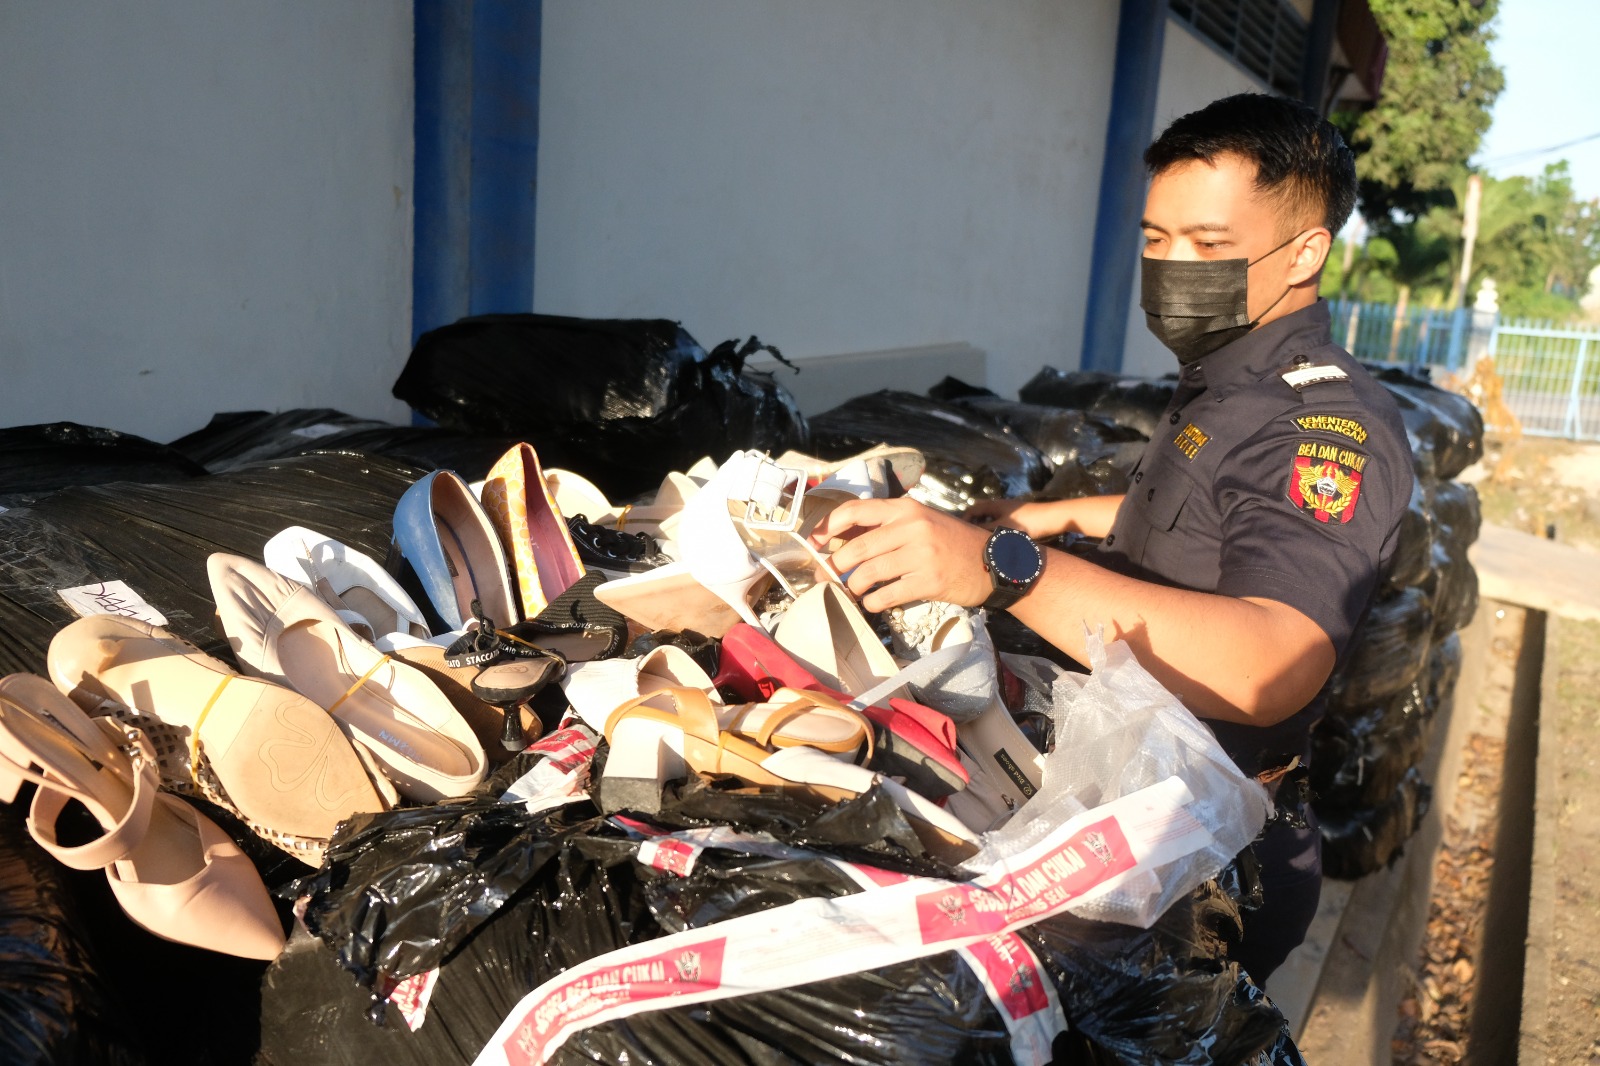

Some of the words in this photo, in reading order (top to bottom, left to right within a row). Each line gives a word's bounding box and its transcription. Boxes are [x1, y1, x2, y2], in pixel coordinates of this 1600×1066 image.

[1297, 415, 1367, 441] KEMENTERIAN
[1303, 422, 1363, 444] KEUANGAN
[1297, 443, 1317, 457] BEA
[1318, 445, 1338, 461] DAN
[1339, 450, 1365, 472] CUKAI
[465, 649, 500, 665] STACCATO
[1016, 868, 1049, 900] DAN
[1041, 846, 1086, 884] CUKAI
[1046, 886, 1071, 905] SEAL
